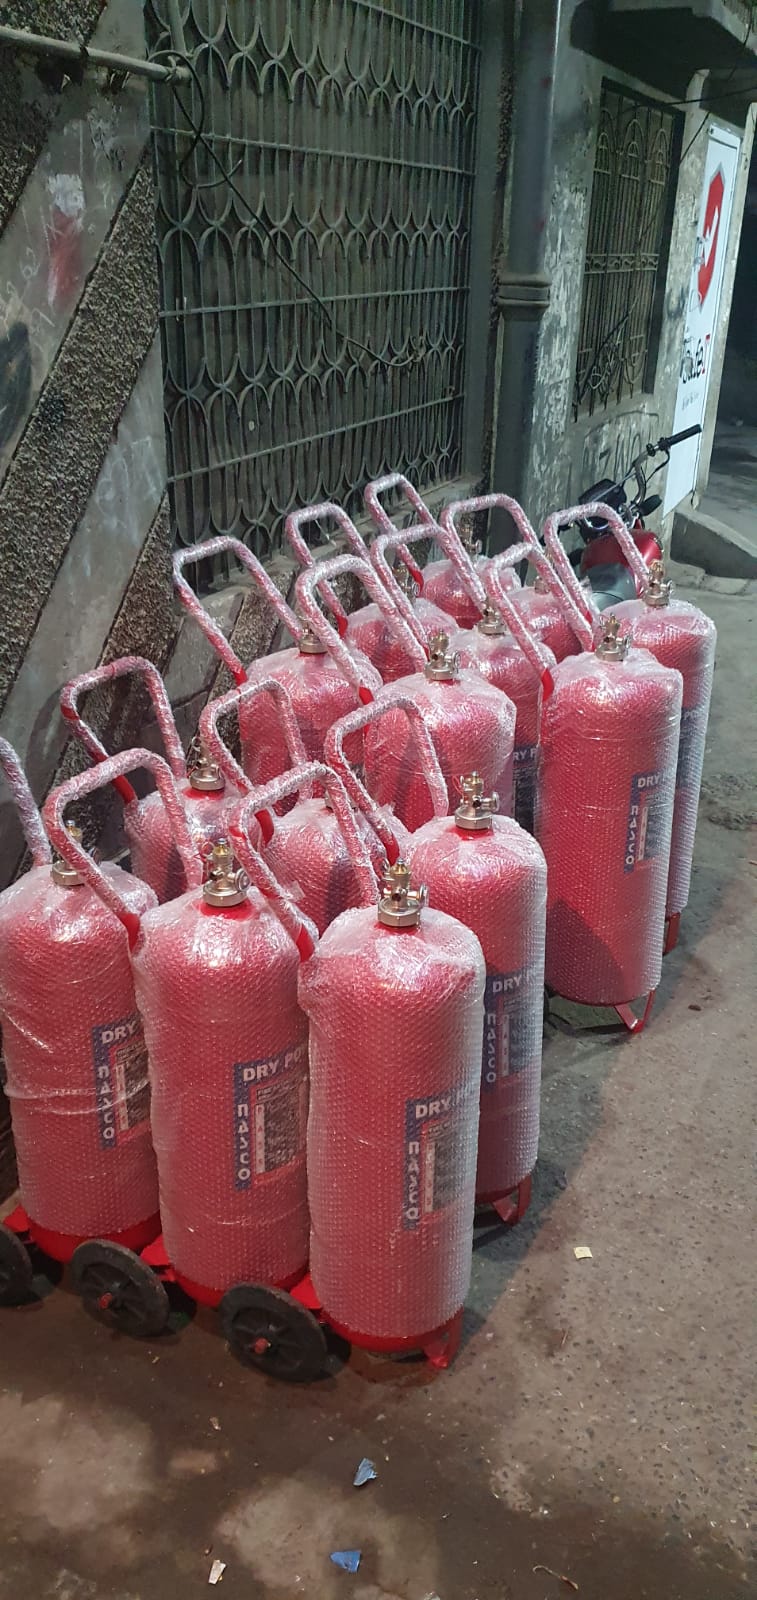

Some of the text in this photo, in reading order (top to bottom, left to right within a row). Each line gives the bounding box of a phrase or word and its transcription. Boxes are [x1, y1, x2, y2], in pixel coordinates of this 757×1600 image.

[512, 750, 527, 761] RY
[637, 775, 660, 788] DRY
[492, 976, 521, 993] DRY
[101, 1020, 137, 1044] DRY
[243, 1059, 279, 1082] DRY
[415, 1096, 450, 1119] DRY
